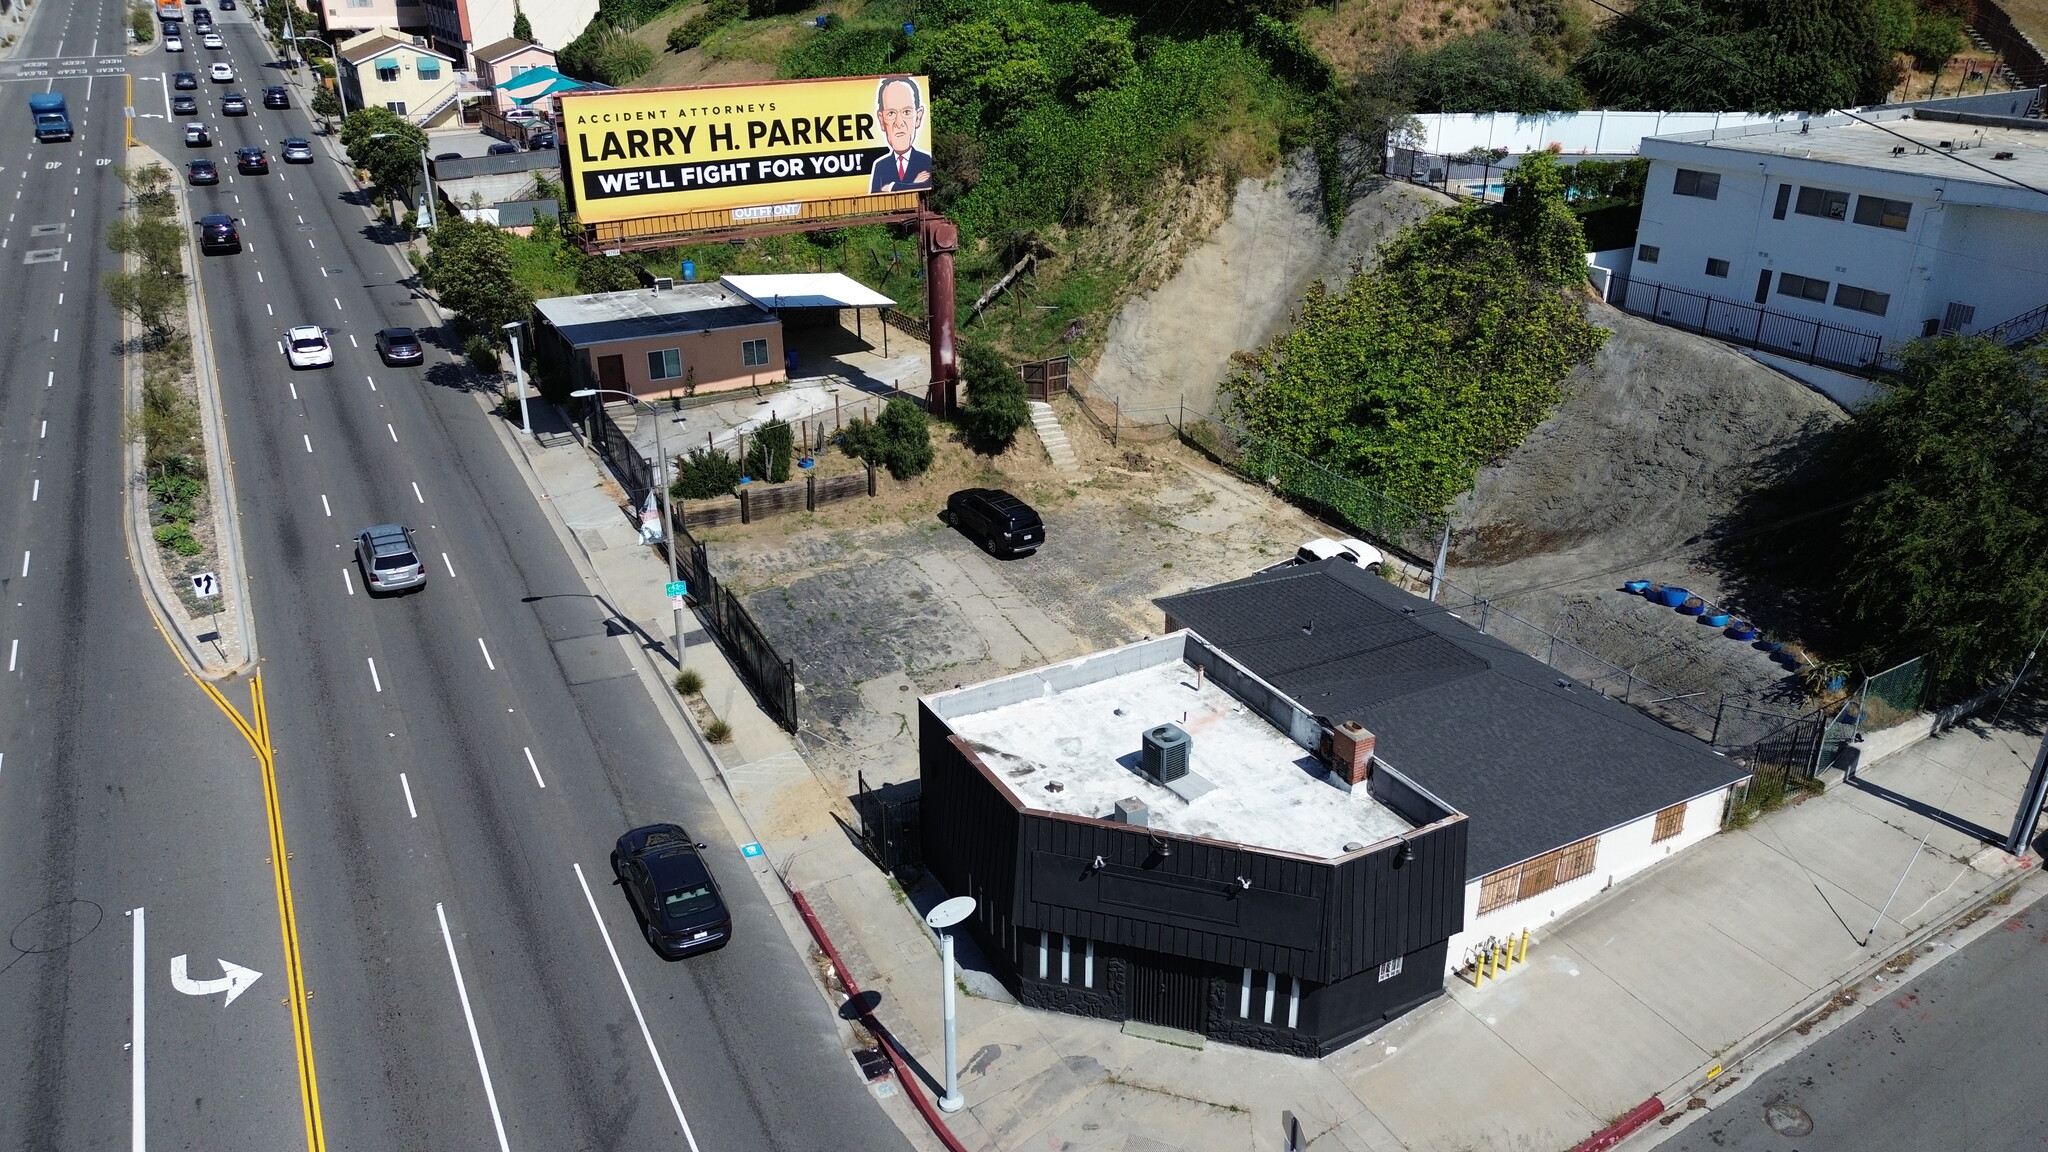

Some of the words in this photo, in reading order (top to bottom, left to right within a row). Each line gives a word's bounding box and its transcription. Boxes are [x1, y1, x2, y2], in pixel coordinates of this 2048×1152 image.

[577, 110, 667, 124] ACCIDENT
[679, 102, 776, 118] ATTORNEYS
[579, 126, 696, 163] LARRY
[709, 122, 740, 152] H.
[747, 113, 875, 149] PARKER
[598, 169, 675, 194] WE'LL
[680, 162, 751, 186] FIGHT
[758, 158, 804, 179] FOR
[809, 153, 863, 174] YOU!
[734, 204, 798, 218] OUTFRONT
